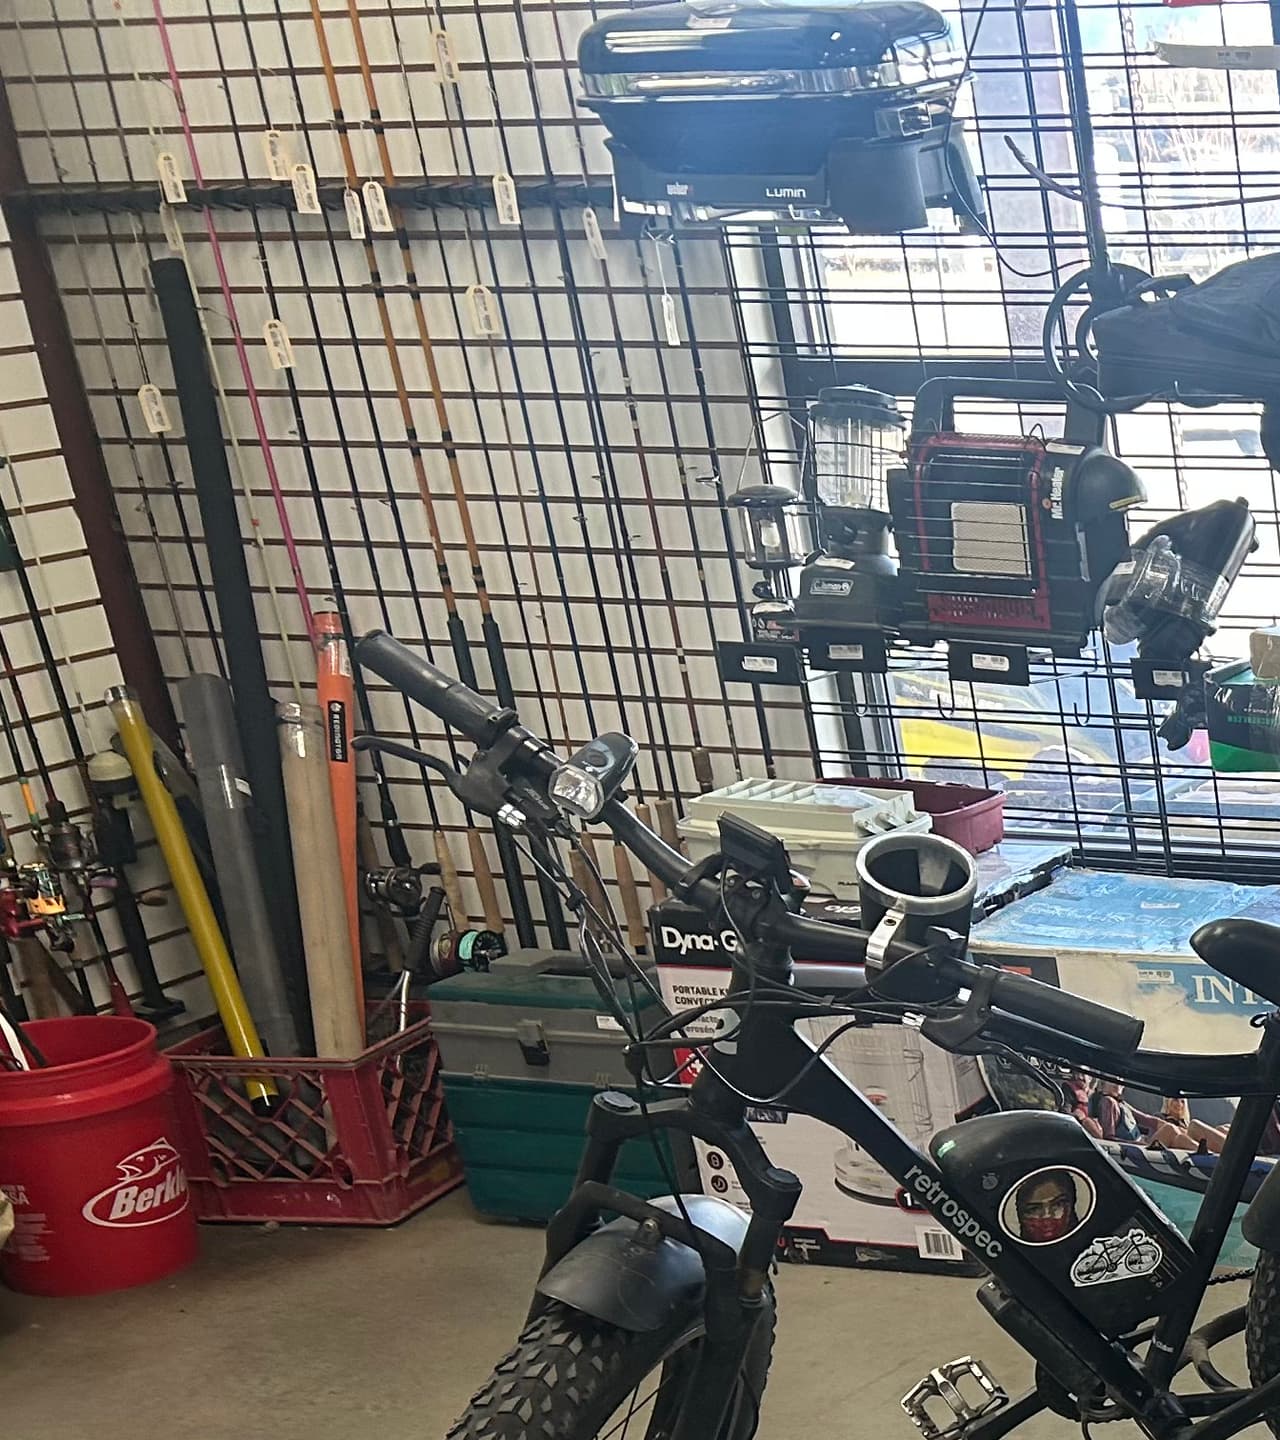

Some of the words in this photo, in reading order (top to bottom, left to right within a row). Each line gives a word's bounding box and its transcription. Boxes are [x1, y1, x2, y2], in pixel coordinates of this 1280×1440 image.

[672, 984, 718, 996] PORTABLE
[1191, 974, 1274, 1005] INT
[904, 1165, 1003, 1258] retrospec
